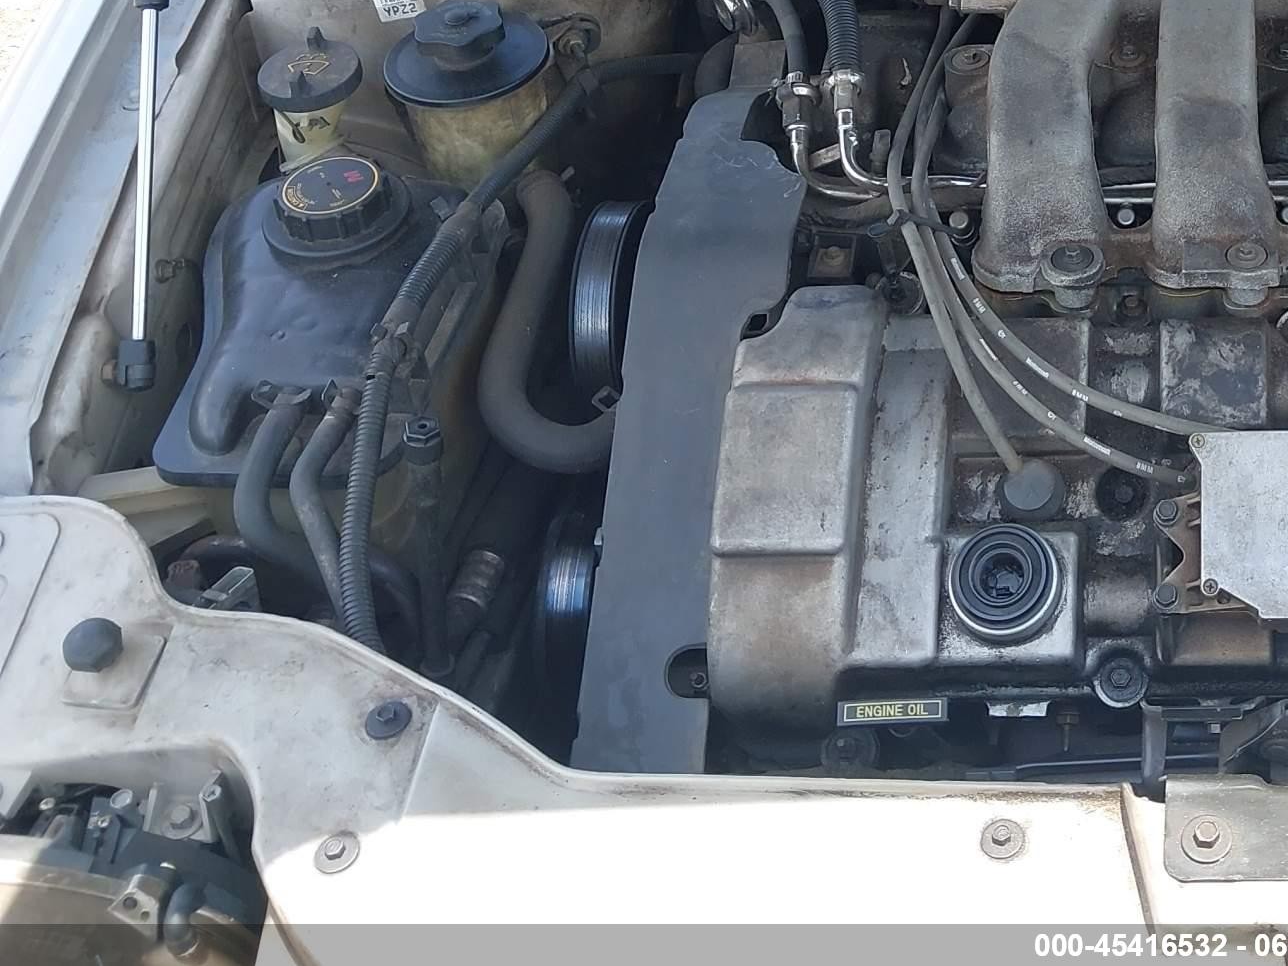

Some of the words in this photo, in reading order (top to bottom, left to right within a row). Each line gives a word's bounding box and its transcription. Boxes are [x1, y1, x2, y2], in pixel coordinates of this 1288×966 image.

[383, 3, 418, 17] YPZ2
[856, 704, 904, 718] ENGINE
[907, 703, 929, 716] OIL
